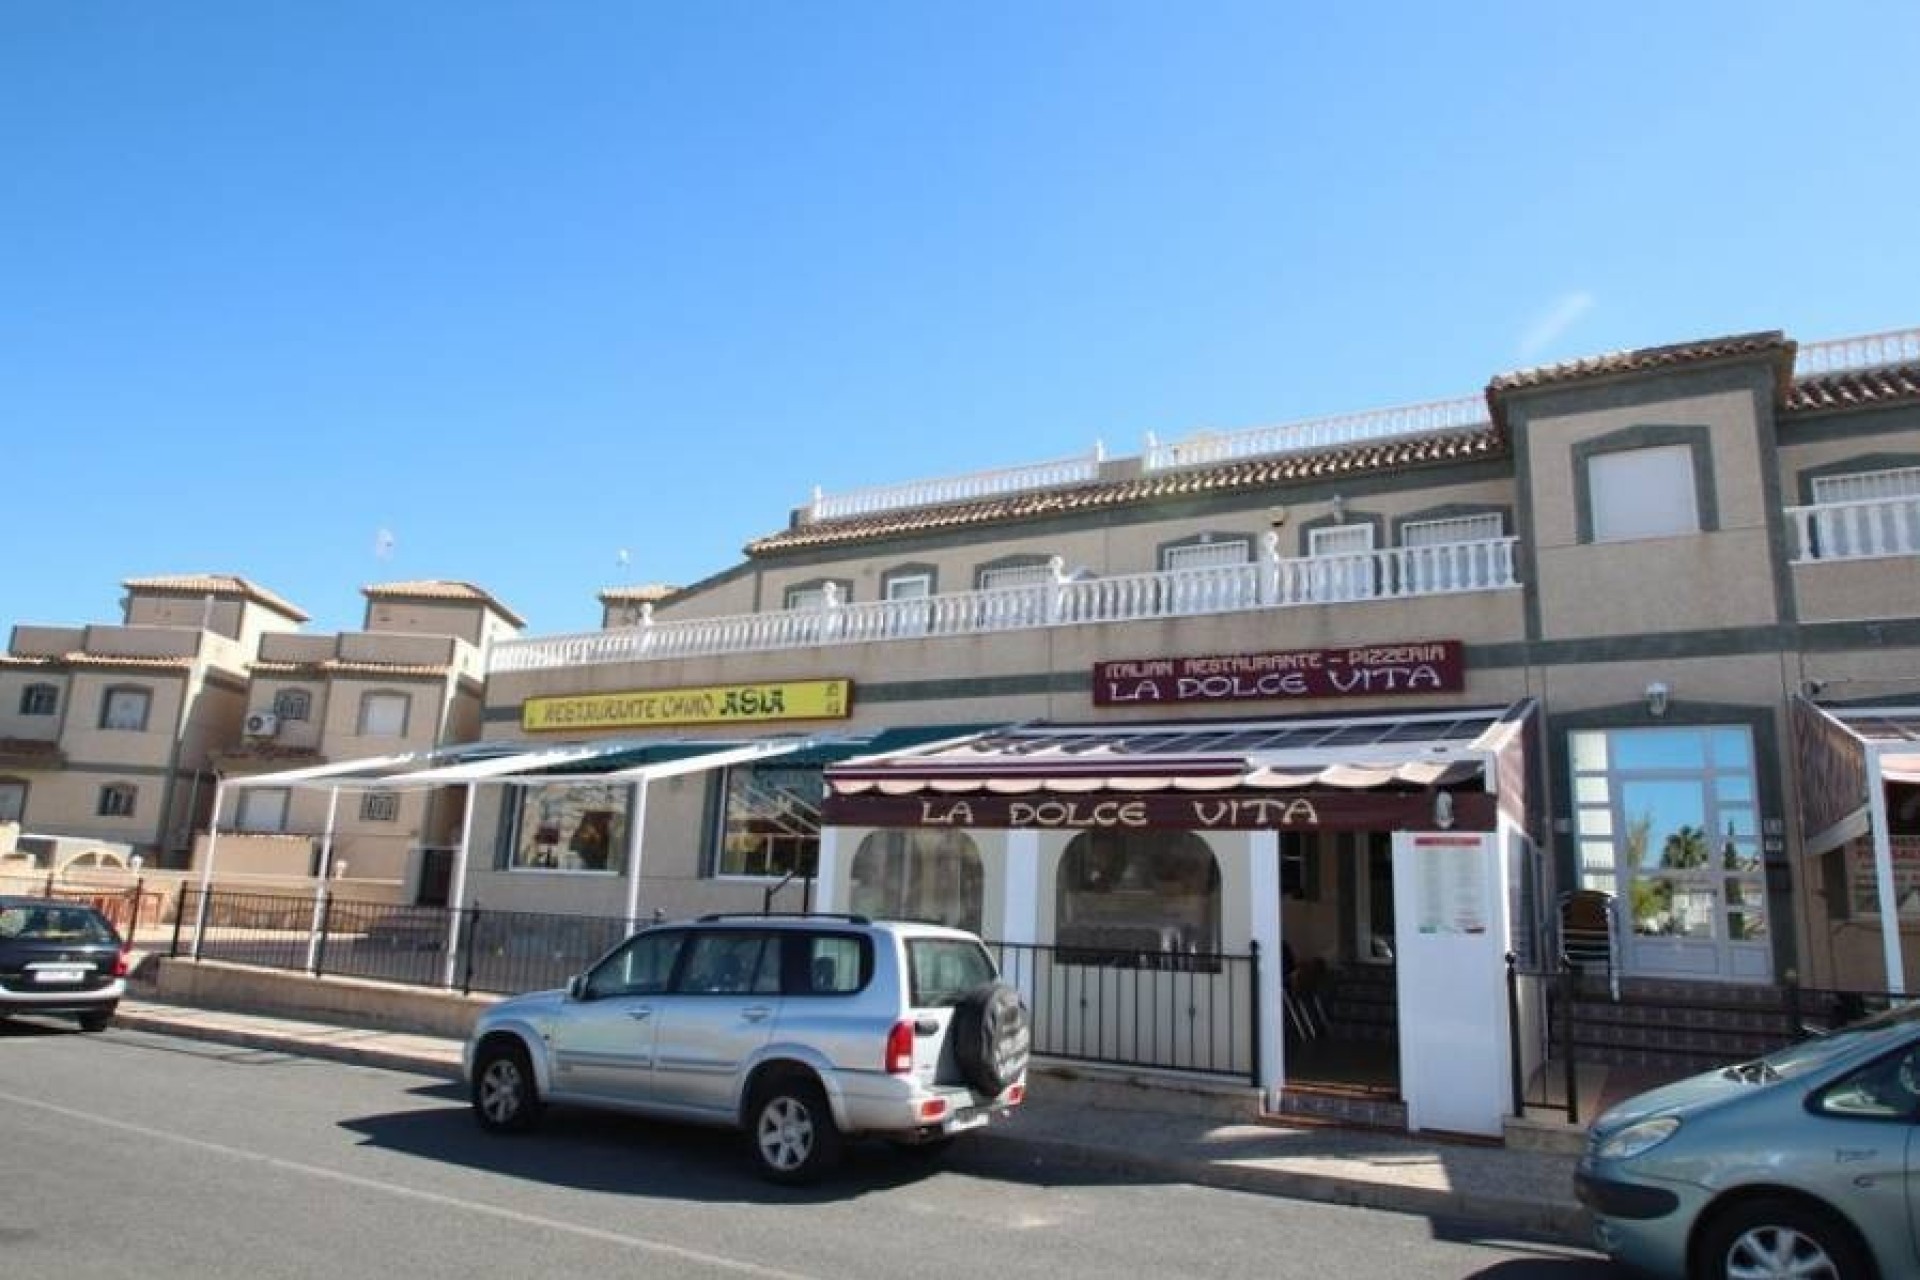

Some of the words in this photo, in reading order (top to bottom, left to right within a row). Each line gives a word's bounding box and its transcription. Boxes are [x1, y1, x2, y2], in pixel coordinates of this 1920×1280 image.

[1105, 661, 1174, 679] ITALIAN
[1184, 653, 1322, 677] RESTAURANTE
[1349, 644, 1446, 665] PIZZERIA
[1111, 680, 1160, 700] LA
[1178, 672, 1308, 699] DOLCE
[1327, 664, 1442, 692] VITA
[720, 689, 785, 715] ASIA
[921, 801, 975, 824] LA
[1009, 801, 1148, 826] DOLCE
[1193, 799, 1318, 825] VITA
